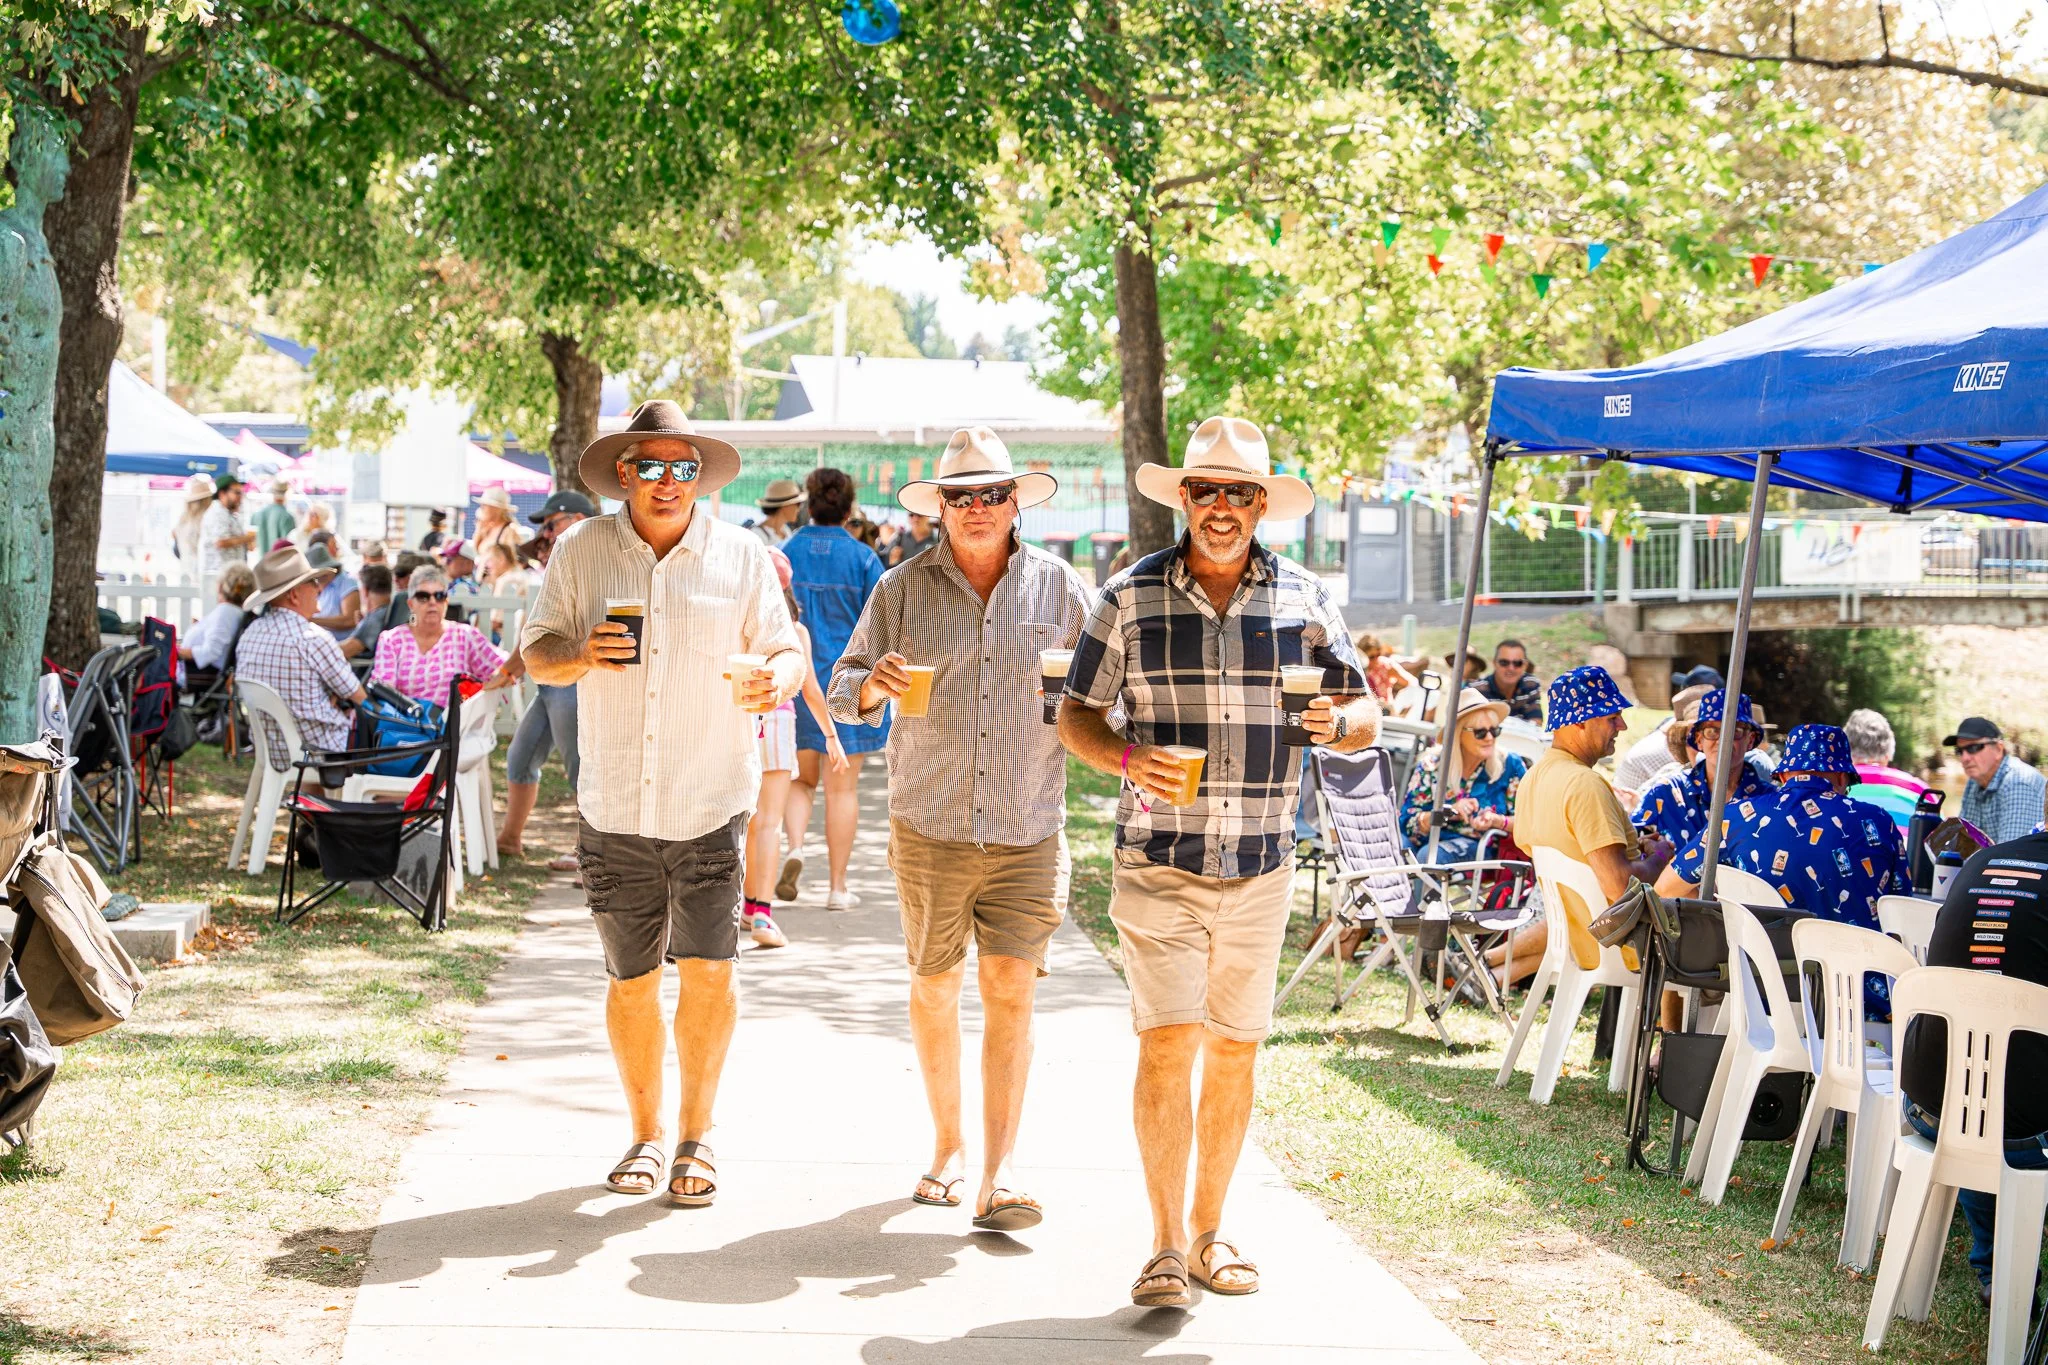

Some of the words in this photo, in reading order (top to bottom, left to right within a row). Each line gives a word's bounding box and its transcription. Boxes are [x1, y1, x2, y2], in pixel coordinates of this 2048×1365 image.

[1956, 365, 2007, 388] KINGS
[1605, 397, 1630, 414] KINGS
[2000, 859, 2037, 868] CHOIRBOYS
